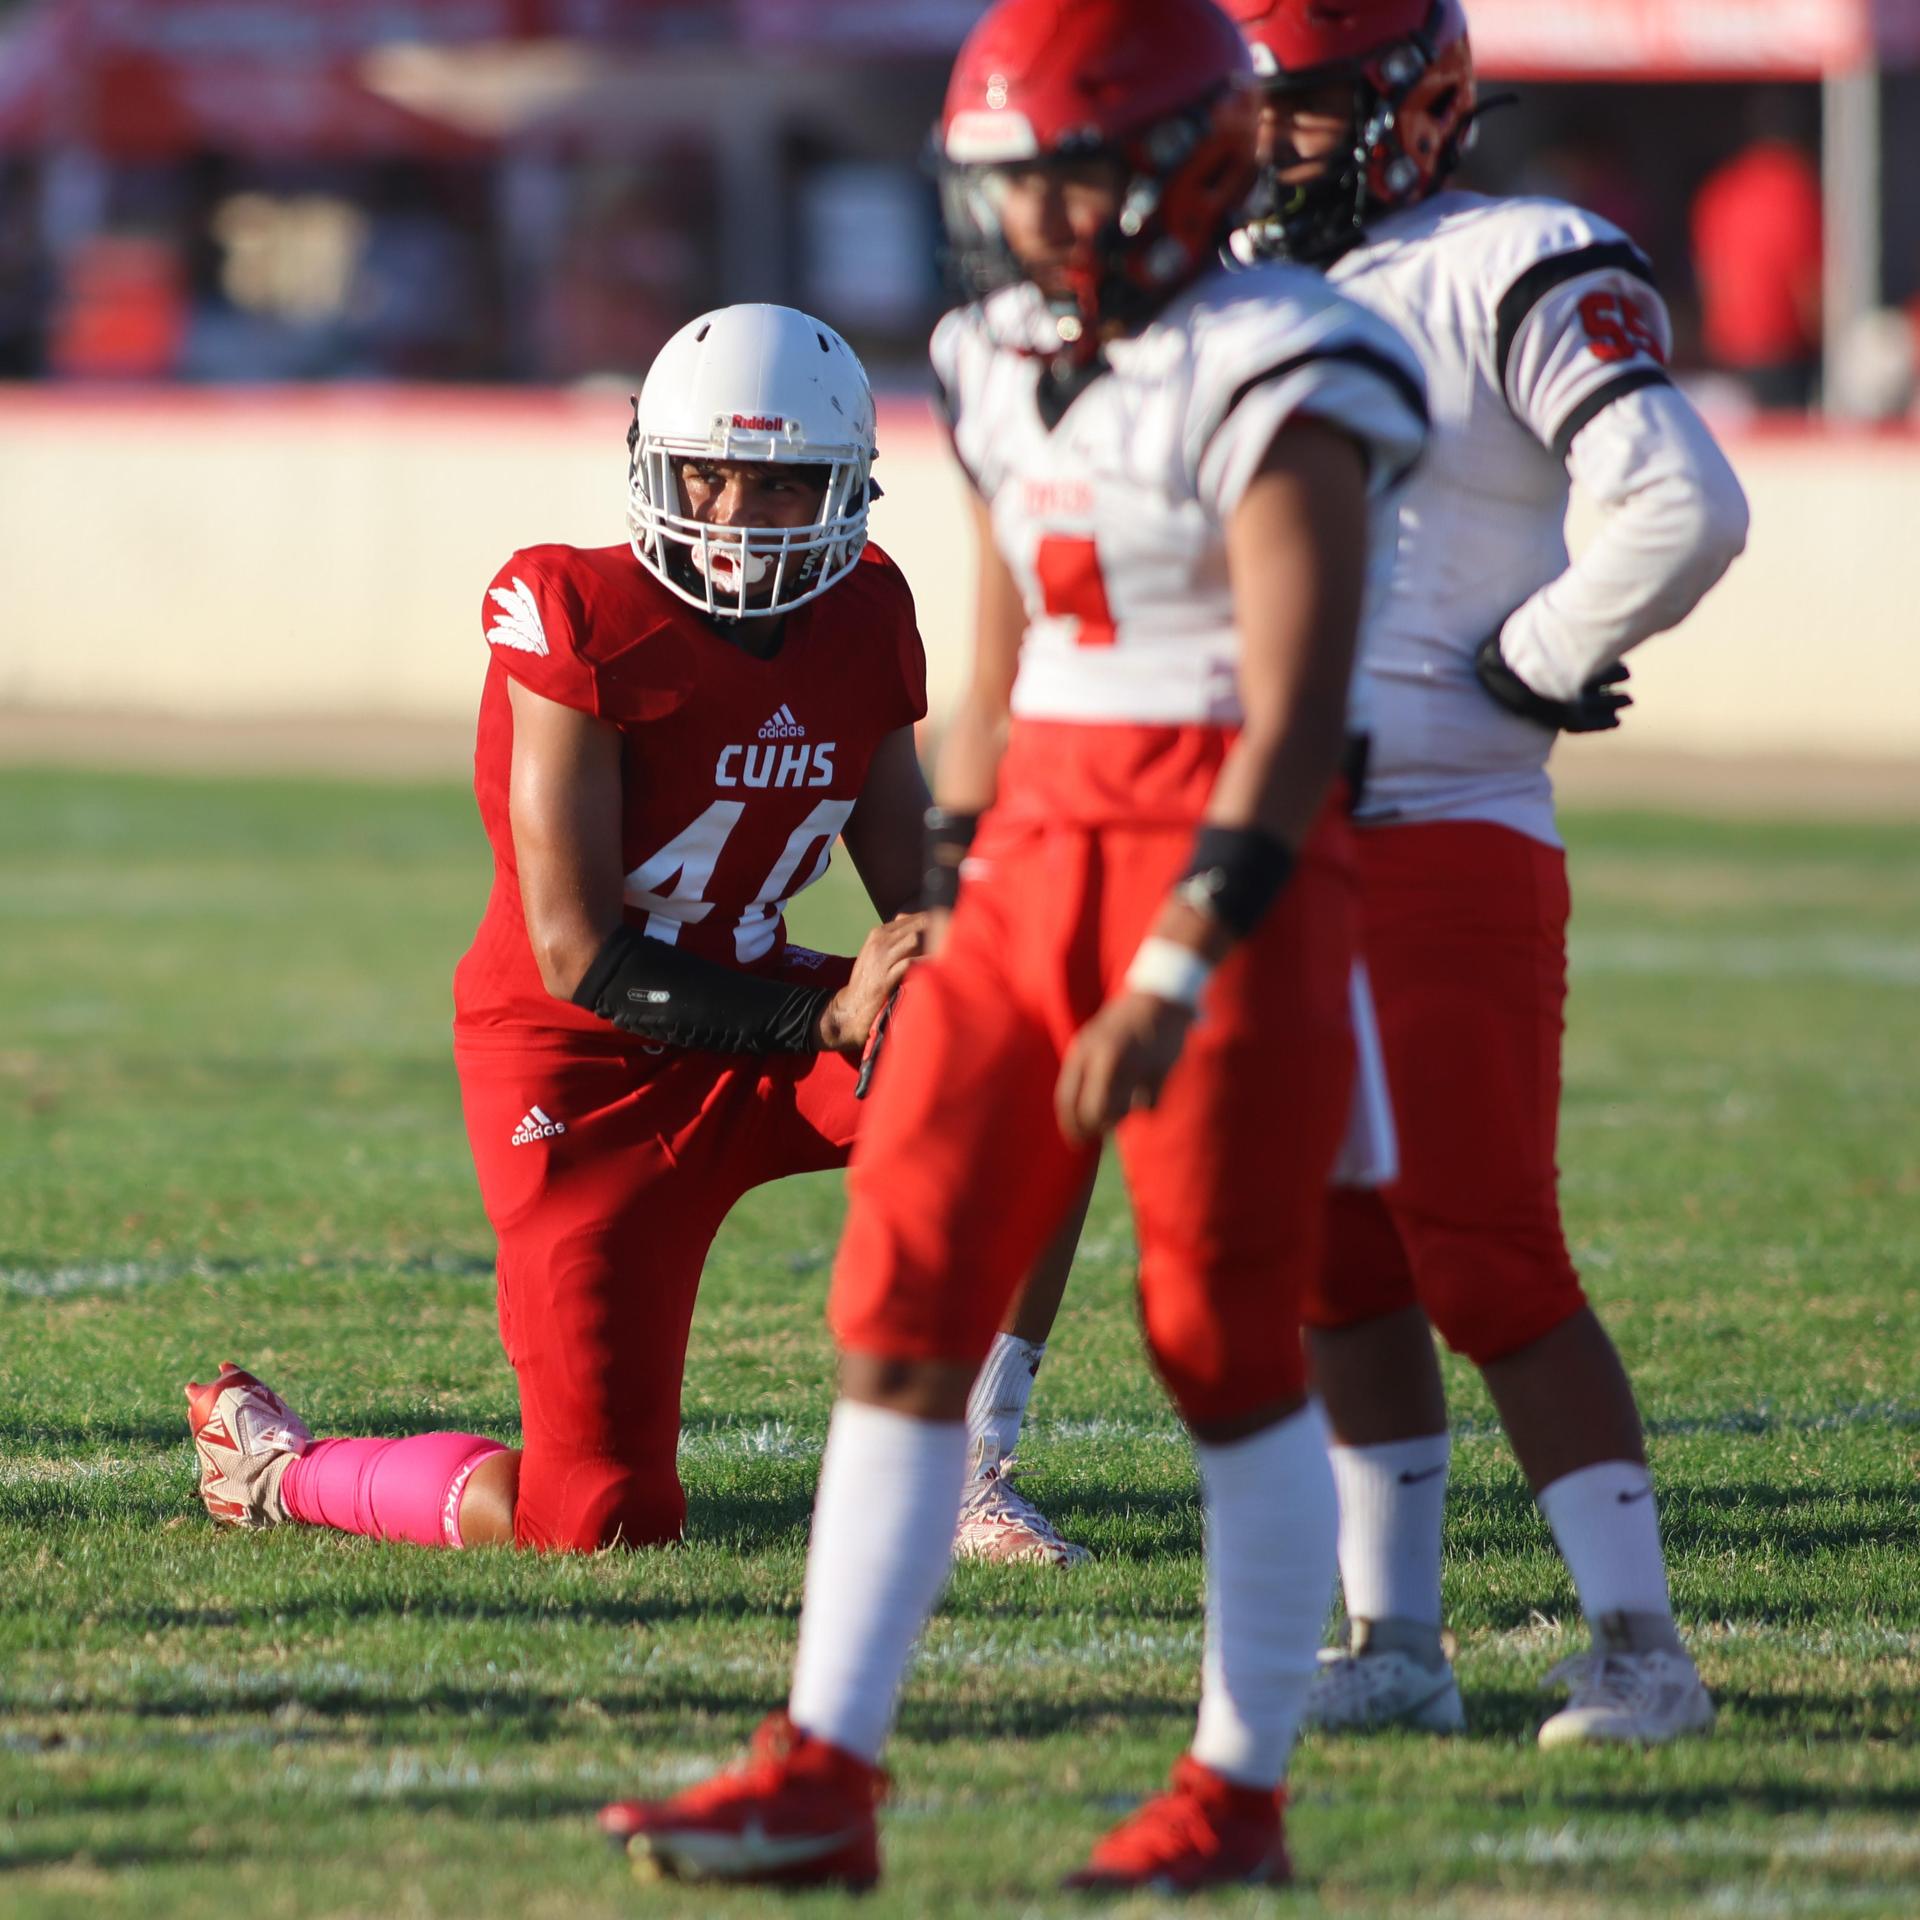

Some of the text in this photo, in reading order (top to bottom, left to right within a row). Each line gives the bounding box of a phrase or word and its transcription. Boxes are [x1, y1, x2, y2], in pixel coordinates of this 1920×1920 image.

[732, 414, 783, 432] Riddell
[758, 724, 806, 739] adidas
[715, 743, 836, 788] CUHS
[624, 798, 857, 964] 40
[511, 1121, 566, 1146] adidas
[444, 1465, 470, 1536] NIKE
